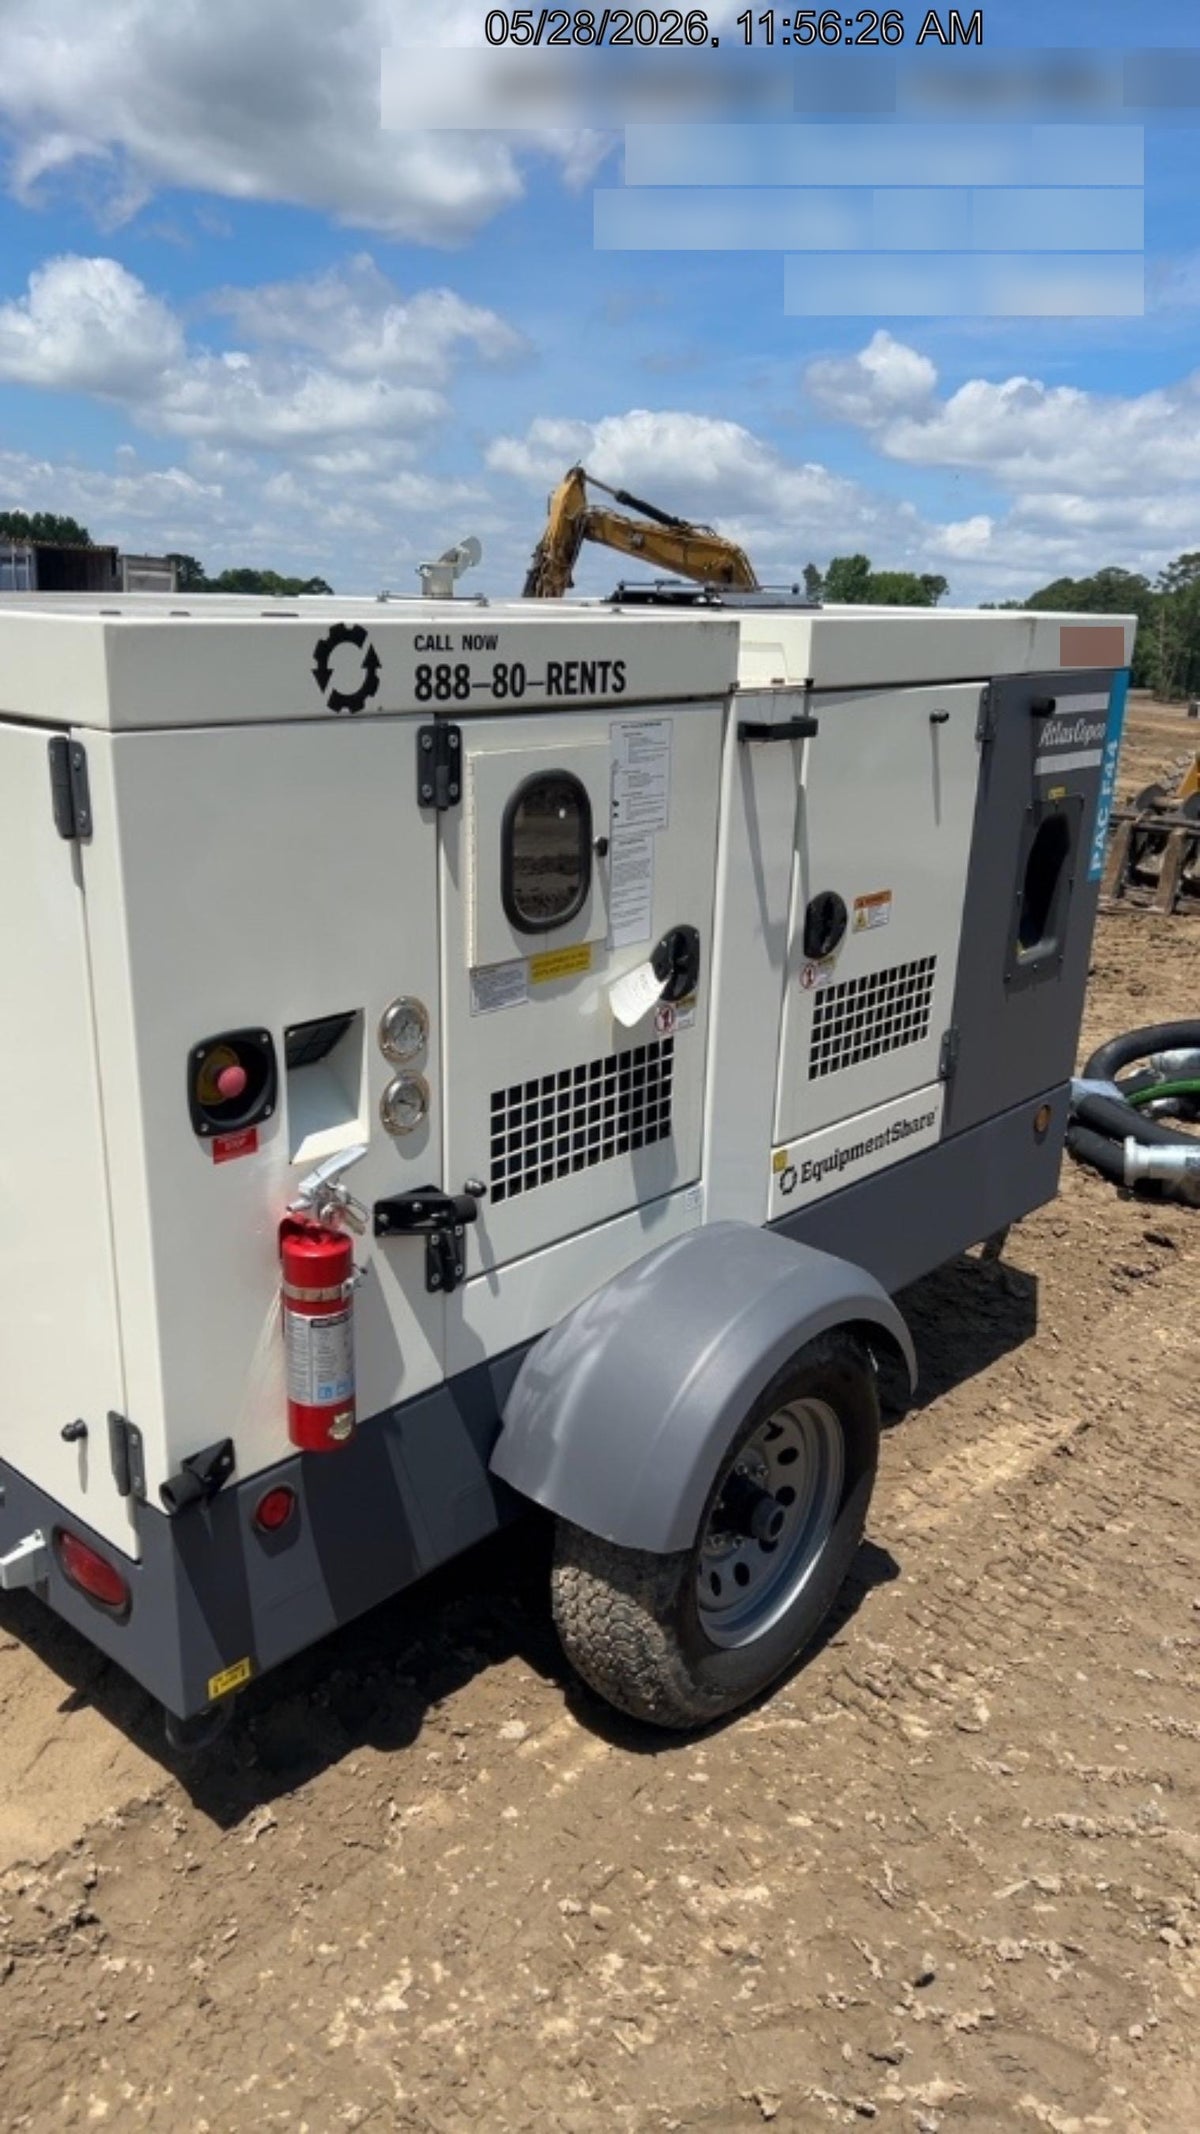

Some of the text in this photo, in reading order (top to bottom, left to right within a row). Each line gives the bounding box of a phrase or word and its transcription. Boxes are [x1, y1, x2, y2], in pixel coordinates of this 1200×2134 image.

[414, 634, 499, 650] CALL NOW
[1090, 806, 1109, 872] PAC
[801, 1111, 936, 1183] EquipmentShare
